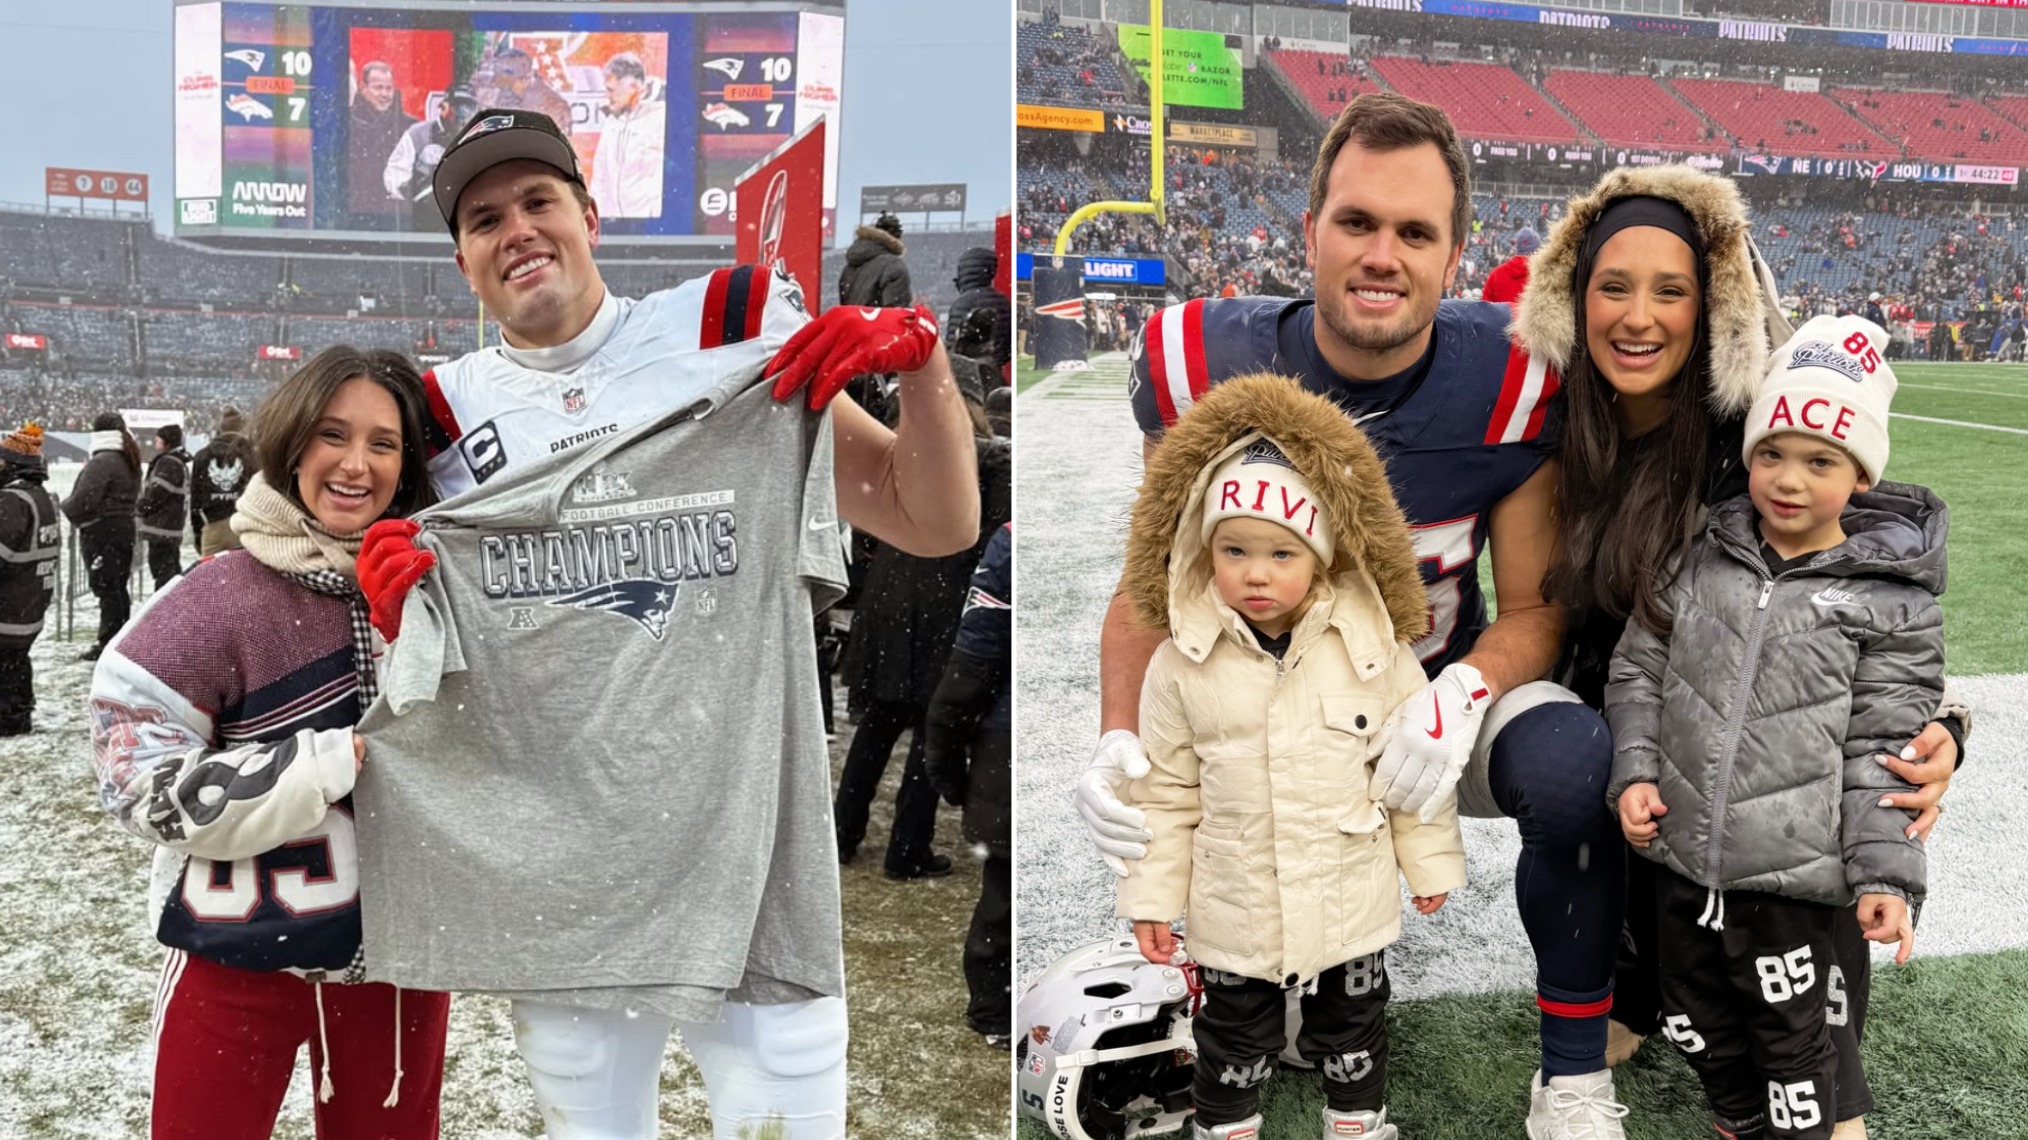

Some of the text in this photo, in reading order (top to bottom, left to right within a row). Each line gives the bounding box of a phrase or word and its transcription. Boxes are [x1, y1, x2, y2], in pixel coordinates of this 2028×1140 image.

[1718, 21, 1787, 42] PATRIOTS
[1886, 33, 1954, 53] PATRIOTS
[282, 51, 312, 75] 10
[761, 57, 792, 81] 10
[1201, 66, 1231, 75] RAZOR
[254, 80, 288, 91] FINAL
[731, 88, 766, 98] FINAL
[288, 97, 306, 121] 7
[765, 103, 784, 127] 7
[1017, 112, 1093, 126] ossAgency.com
[1190, 126, 1234, 138] MARKETPLACE
[1472, 142, 1482, 156] 0
[1548, 147, 1557, 161] 0
[1617, 151, 1627, 165] 0
[1687, 155, 1724, 169] Gillette
[1792, 159, 1834, 174] NE 0
[1893, 164, 1940, 178] HOU 0
[1971, 169, 1999, 180] 44:22
[232, 203, 306, 218] Five Years Out
[1084, 262, 1134, 278] LIGHT
[1787, 340, 1864, 383] Patriots
[1843, 331, 1881, 374] 85
[1768, 394, 1856, 440] ACE
[463, 427, 500, 471] C
[562, 491, 727, 521] FOOTBALL CONFERENCE
[1221, 480, 1318, 536] RIVI
[480, 509, 738, 599] CHAMPIONS
[1820, 586, 1854, 602] NIKE
[1755, 944, 1816, 1003] 85
[1054, 1075, 1069, 1114] LOVE
[1767, 1079, 1822, 1130] 85
